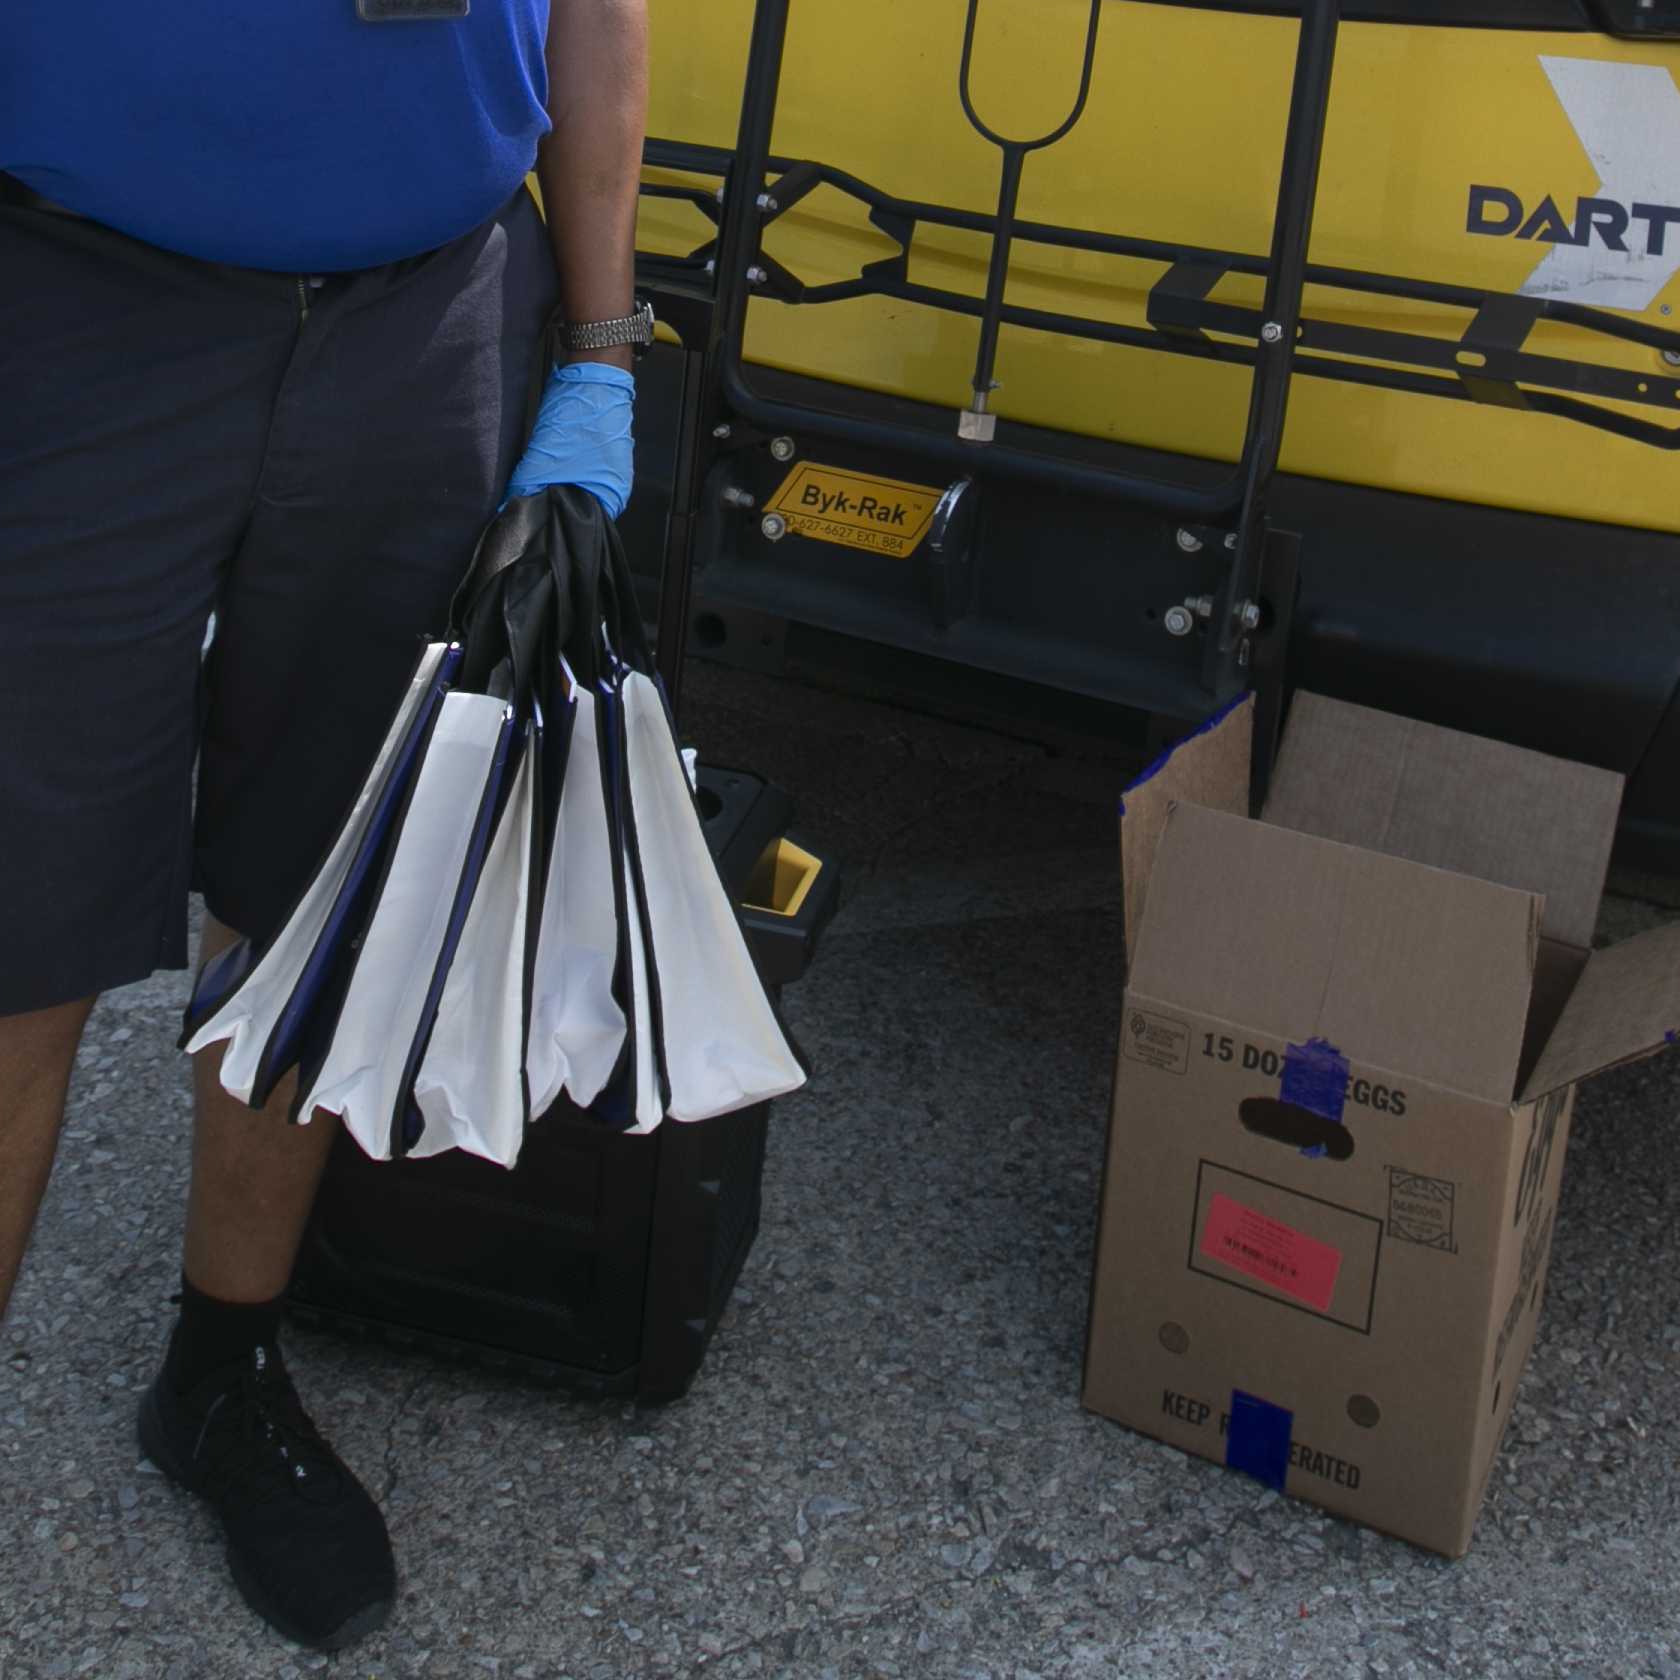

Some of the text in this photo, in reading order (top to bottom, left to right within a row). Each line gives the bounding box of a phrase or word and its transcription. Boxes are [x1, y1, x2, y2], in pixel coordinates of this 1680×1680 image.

[801, 484, 908, 526] Byk-Rak
[857, 531, 880, 546] EXT.
[882, 535, 904, 551] 884
[1202, 1032, 1234, 1062] 15
[1162, 1390, 1211, 1427] KEEP
